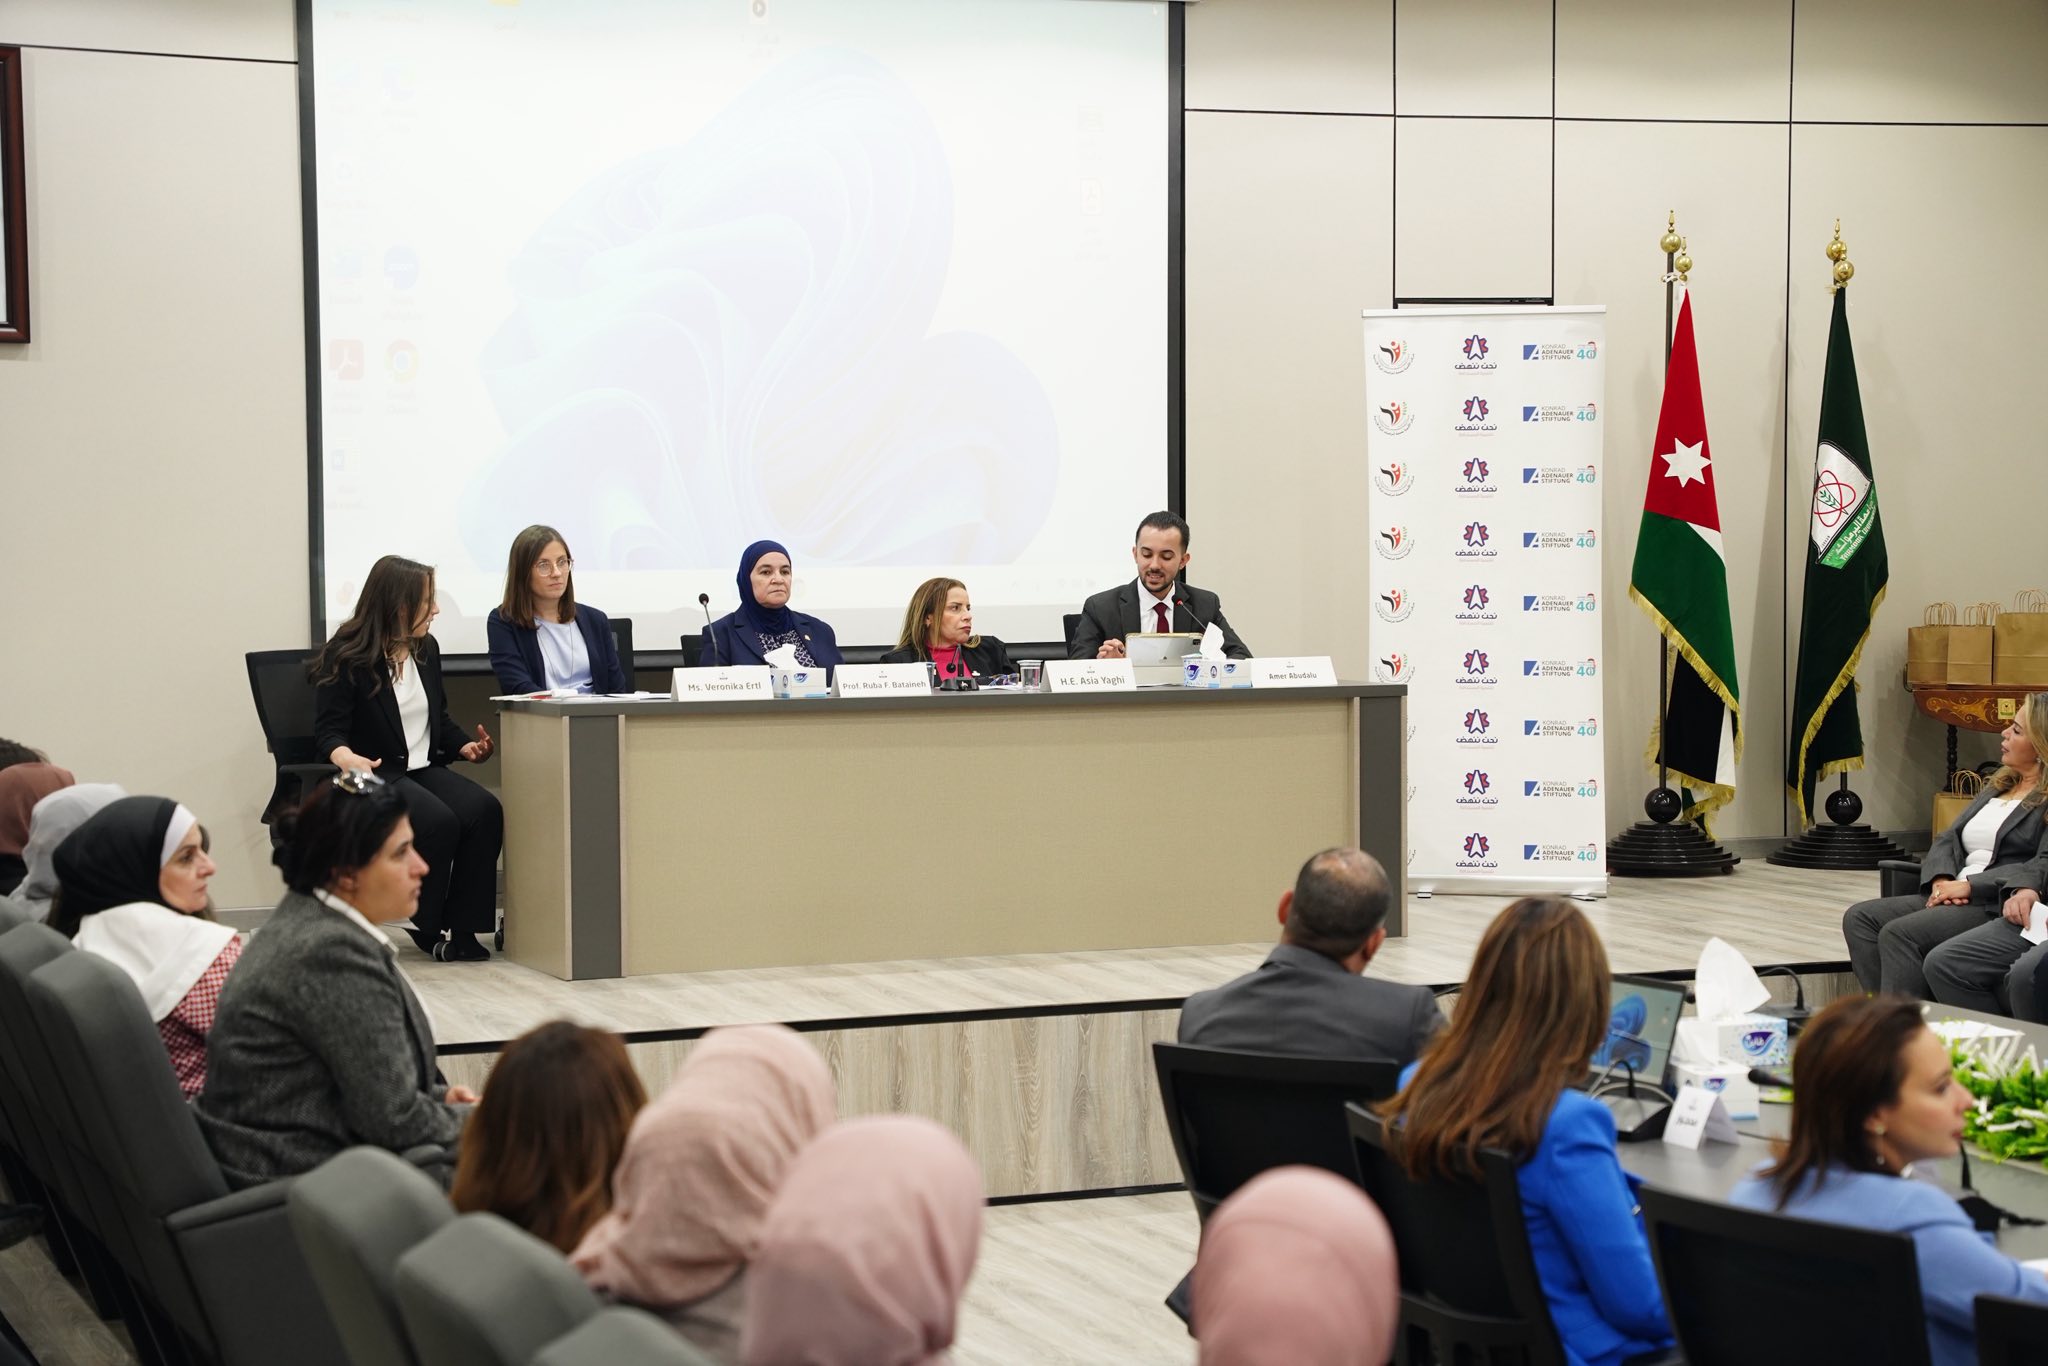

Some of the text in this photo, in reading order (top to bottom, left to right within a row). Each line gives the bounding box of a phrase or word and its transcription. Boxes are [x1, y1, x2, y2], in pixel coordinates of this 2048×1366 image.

[1060, 676, 1125, 686] H.E. Asia Yaghi
[704, 682, 744, 691] Veronika
[746, 682, 762, 690] Ertl
